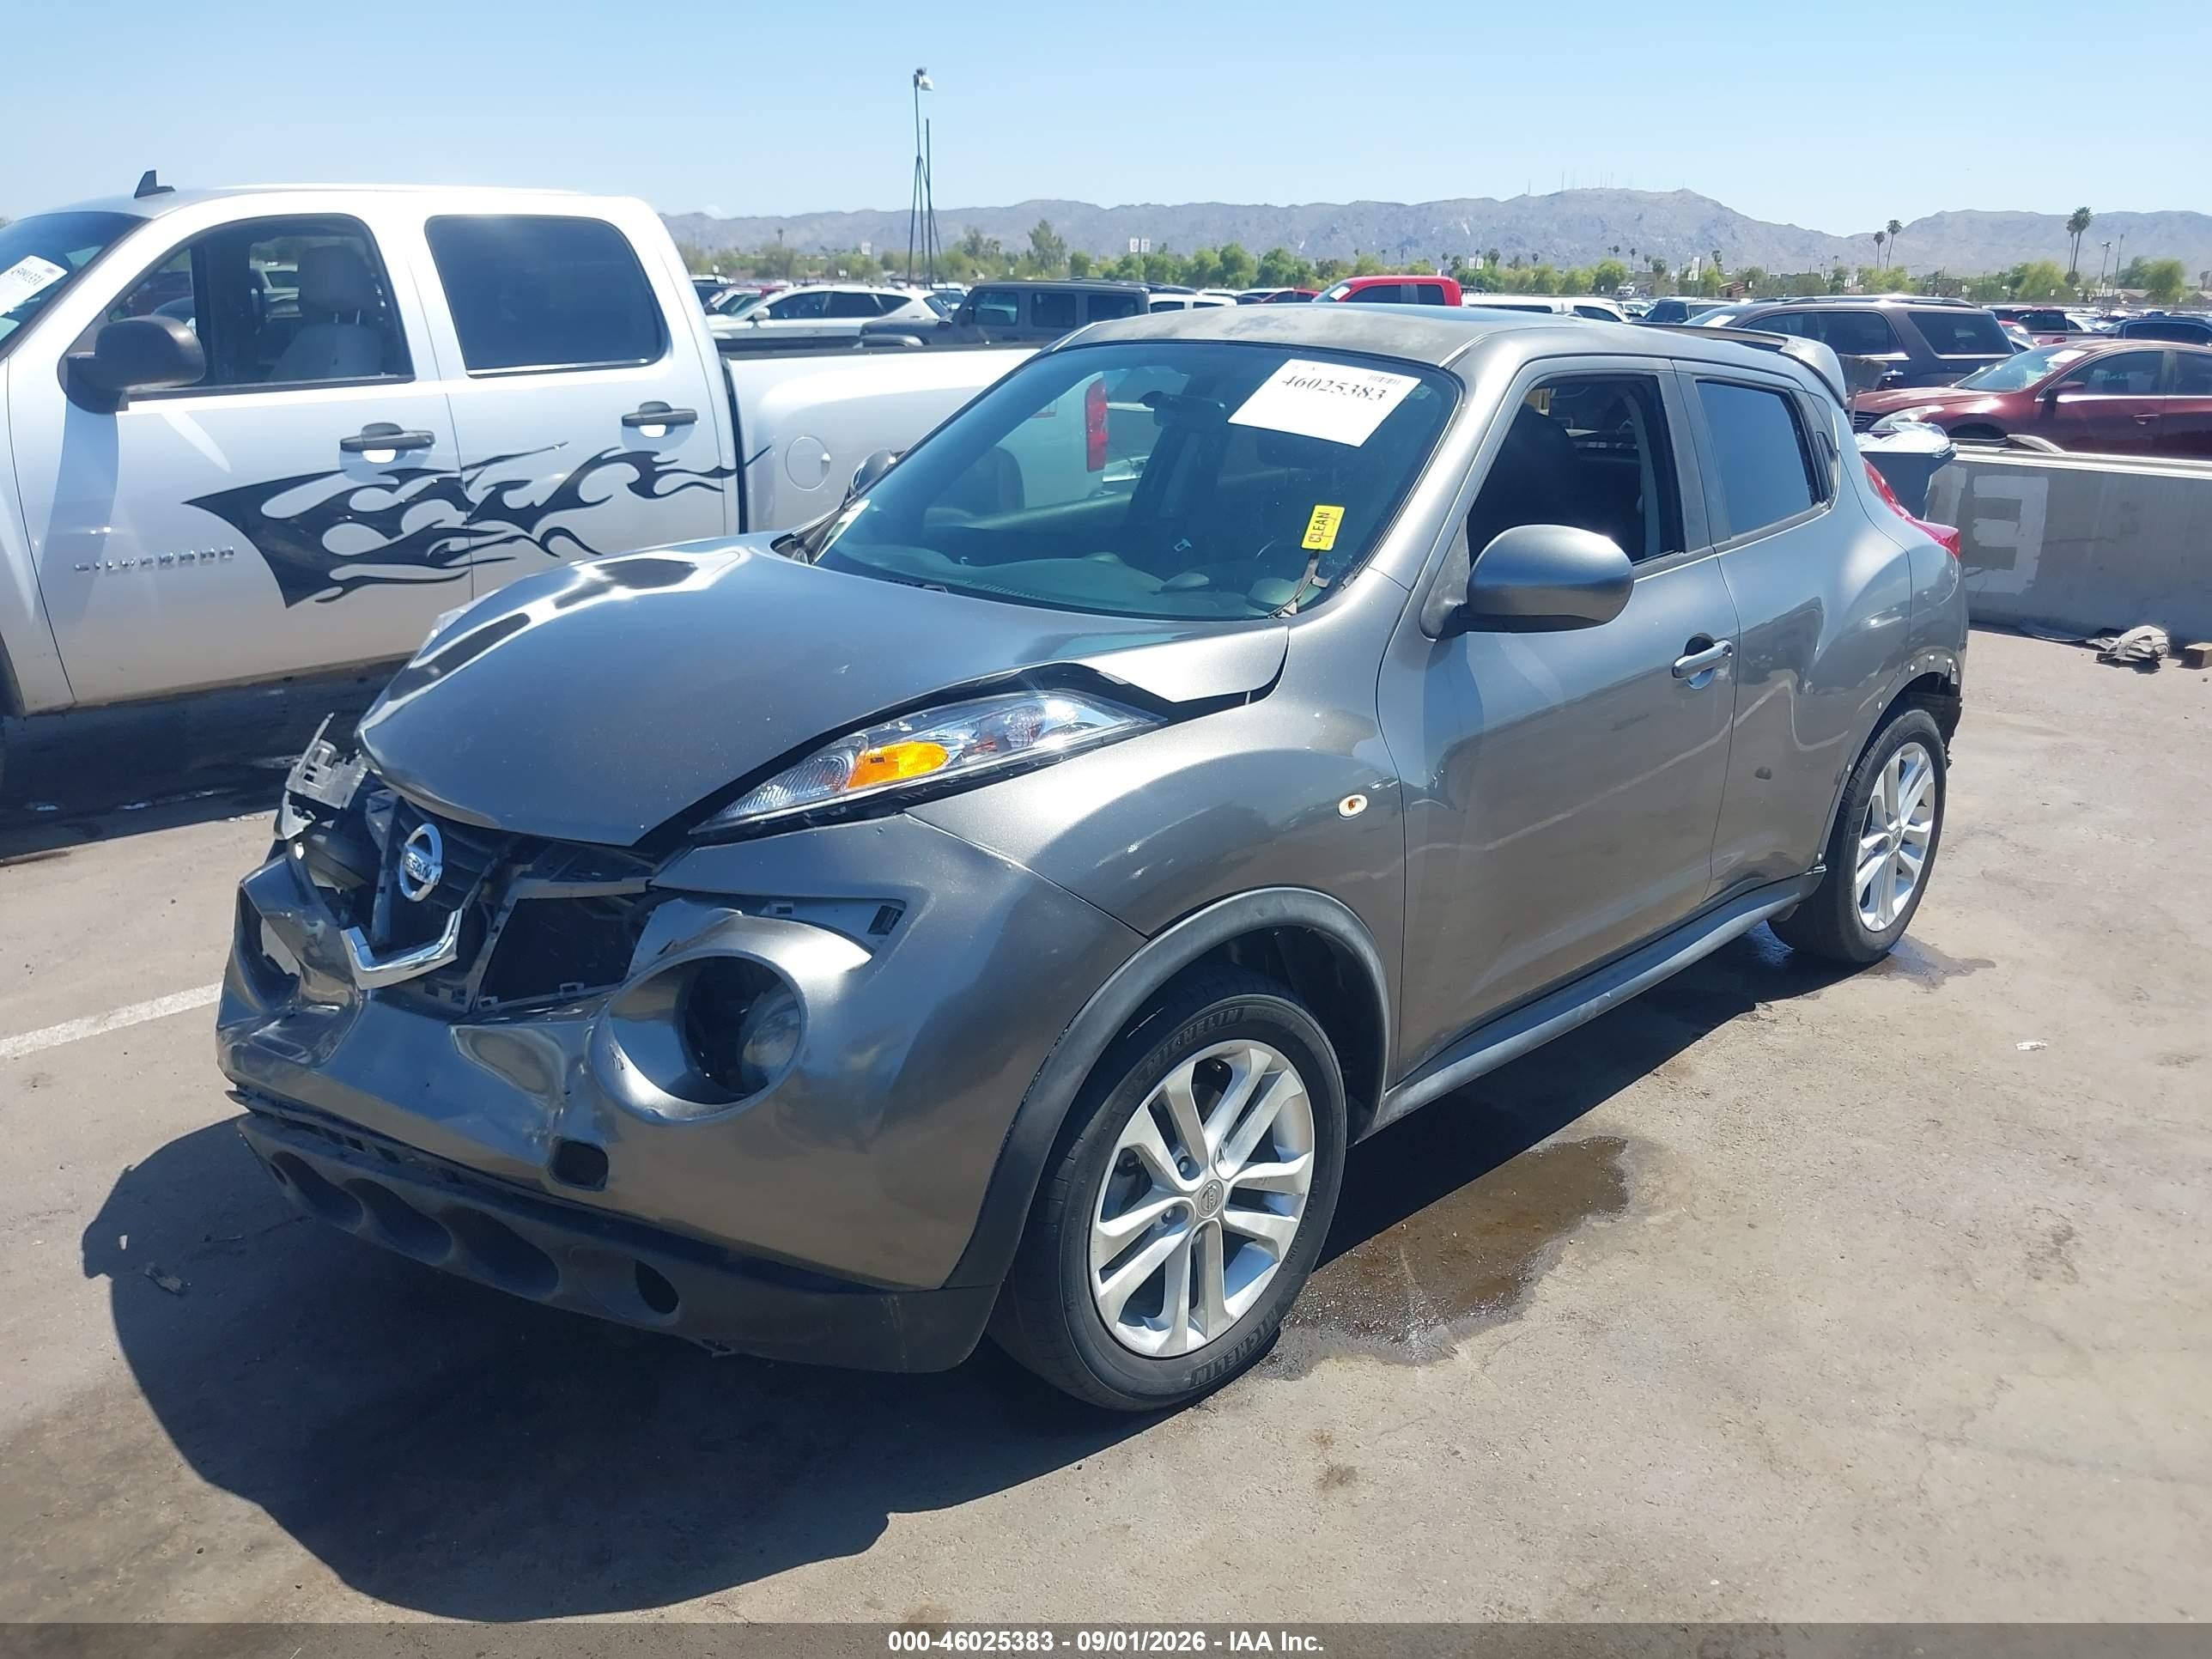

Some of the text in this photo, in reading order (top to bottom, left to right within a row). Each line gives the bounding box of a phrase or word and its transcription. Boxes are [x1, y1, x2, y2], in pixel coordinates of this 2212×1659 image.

[1281, 374, 1387, 402] 46025383
[1308, 512, 1330, 543] CLEAN
[1146, 1006, 1241, 1074] MICHELIN
[1194, 1304, 1280, 1386] MICHELIN
